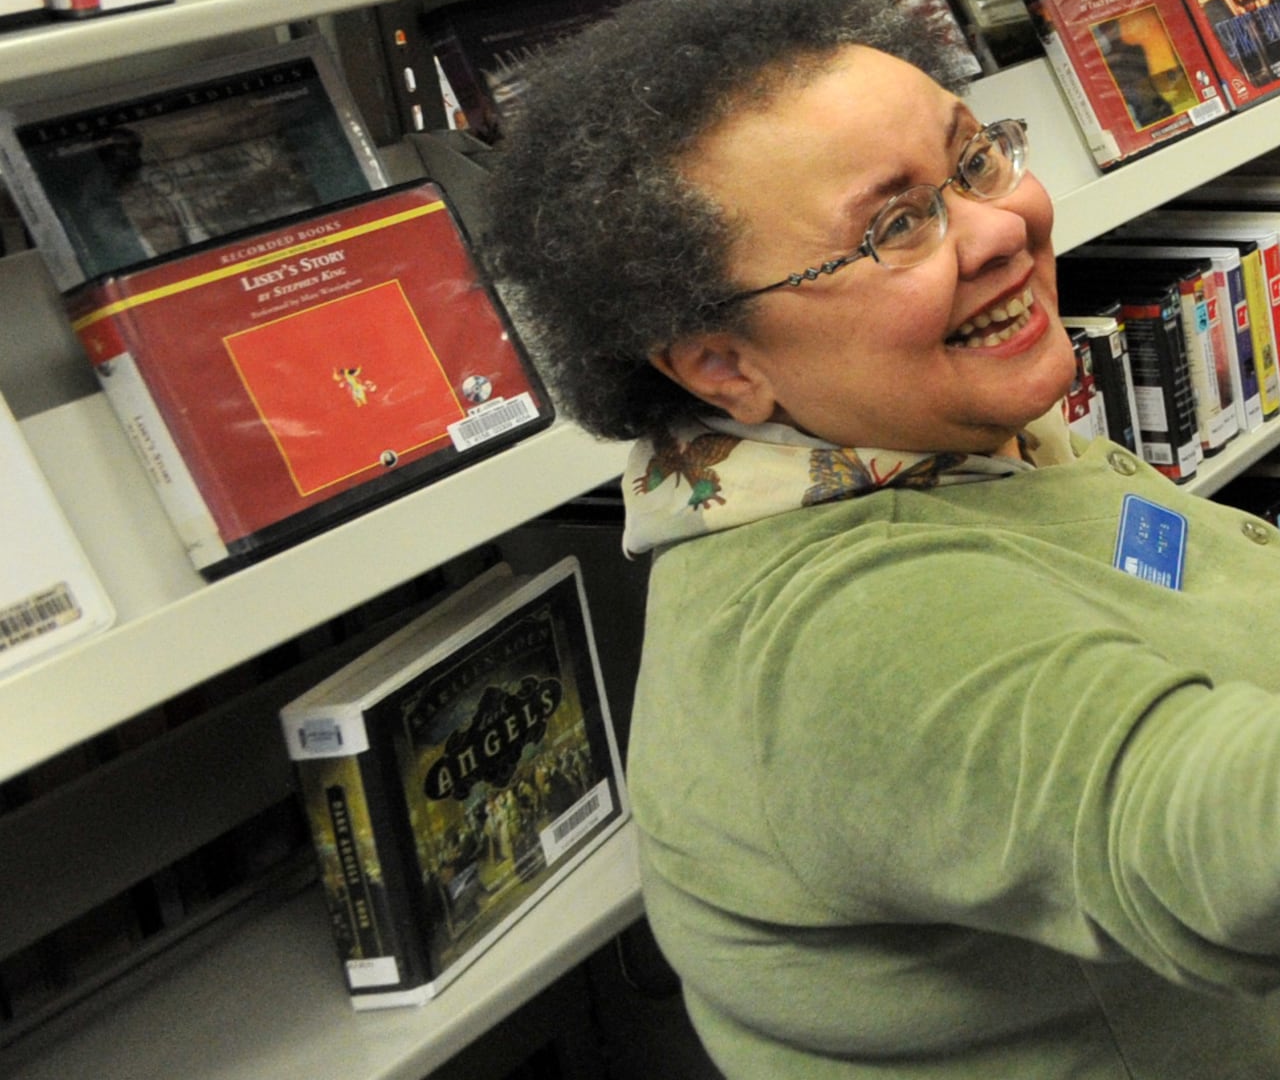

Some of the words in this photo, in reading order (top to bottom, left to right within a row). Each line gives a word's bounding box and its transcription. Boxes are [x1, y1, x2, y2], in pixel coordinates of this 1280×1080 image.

[221, 235, 295, 265] RECORDED
[298, 220, 342, 243] BOOKS
[240, 264, 298, 292] LISEY'S
[300, 249, 346, 274] STORY
[273, 276, 321, 298] STEPHEN
[321, 266, 347, 284] KING
[437, 690, 560, 796] ANGELS
